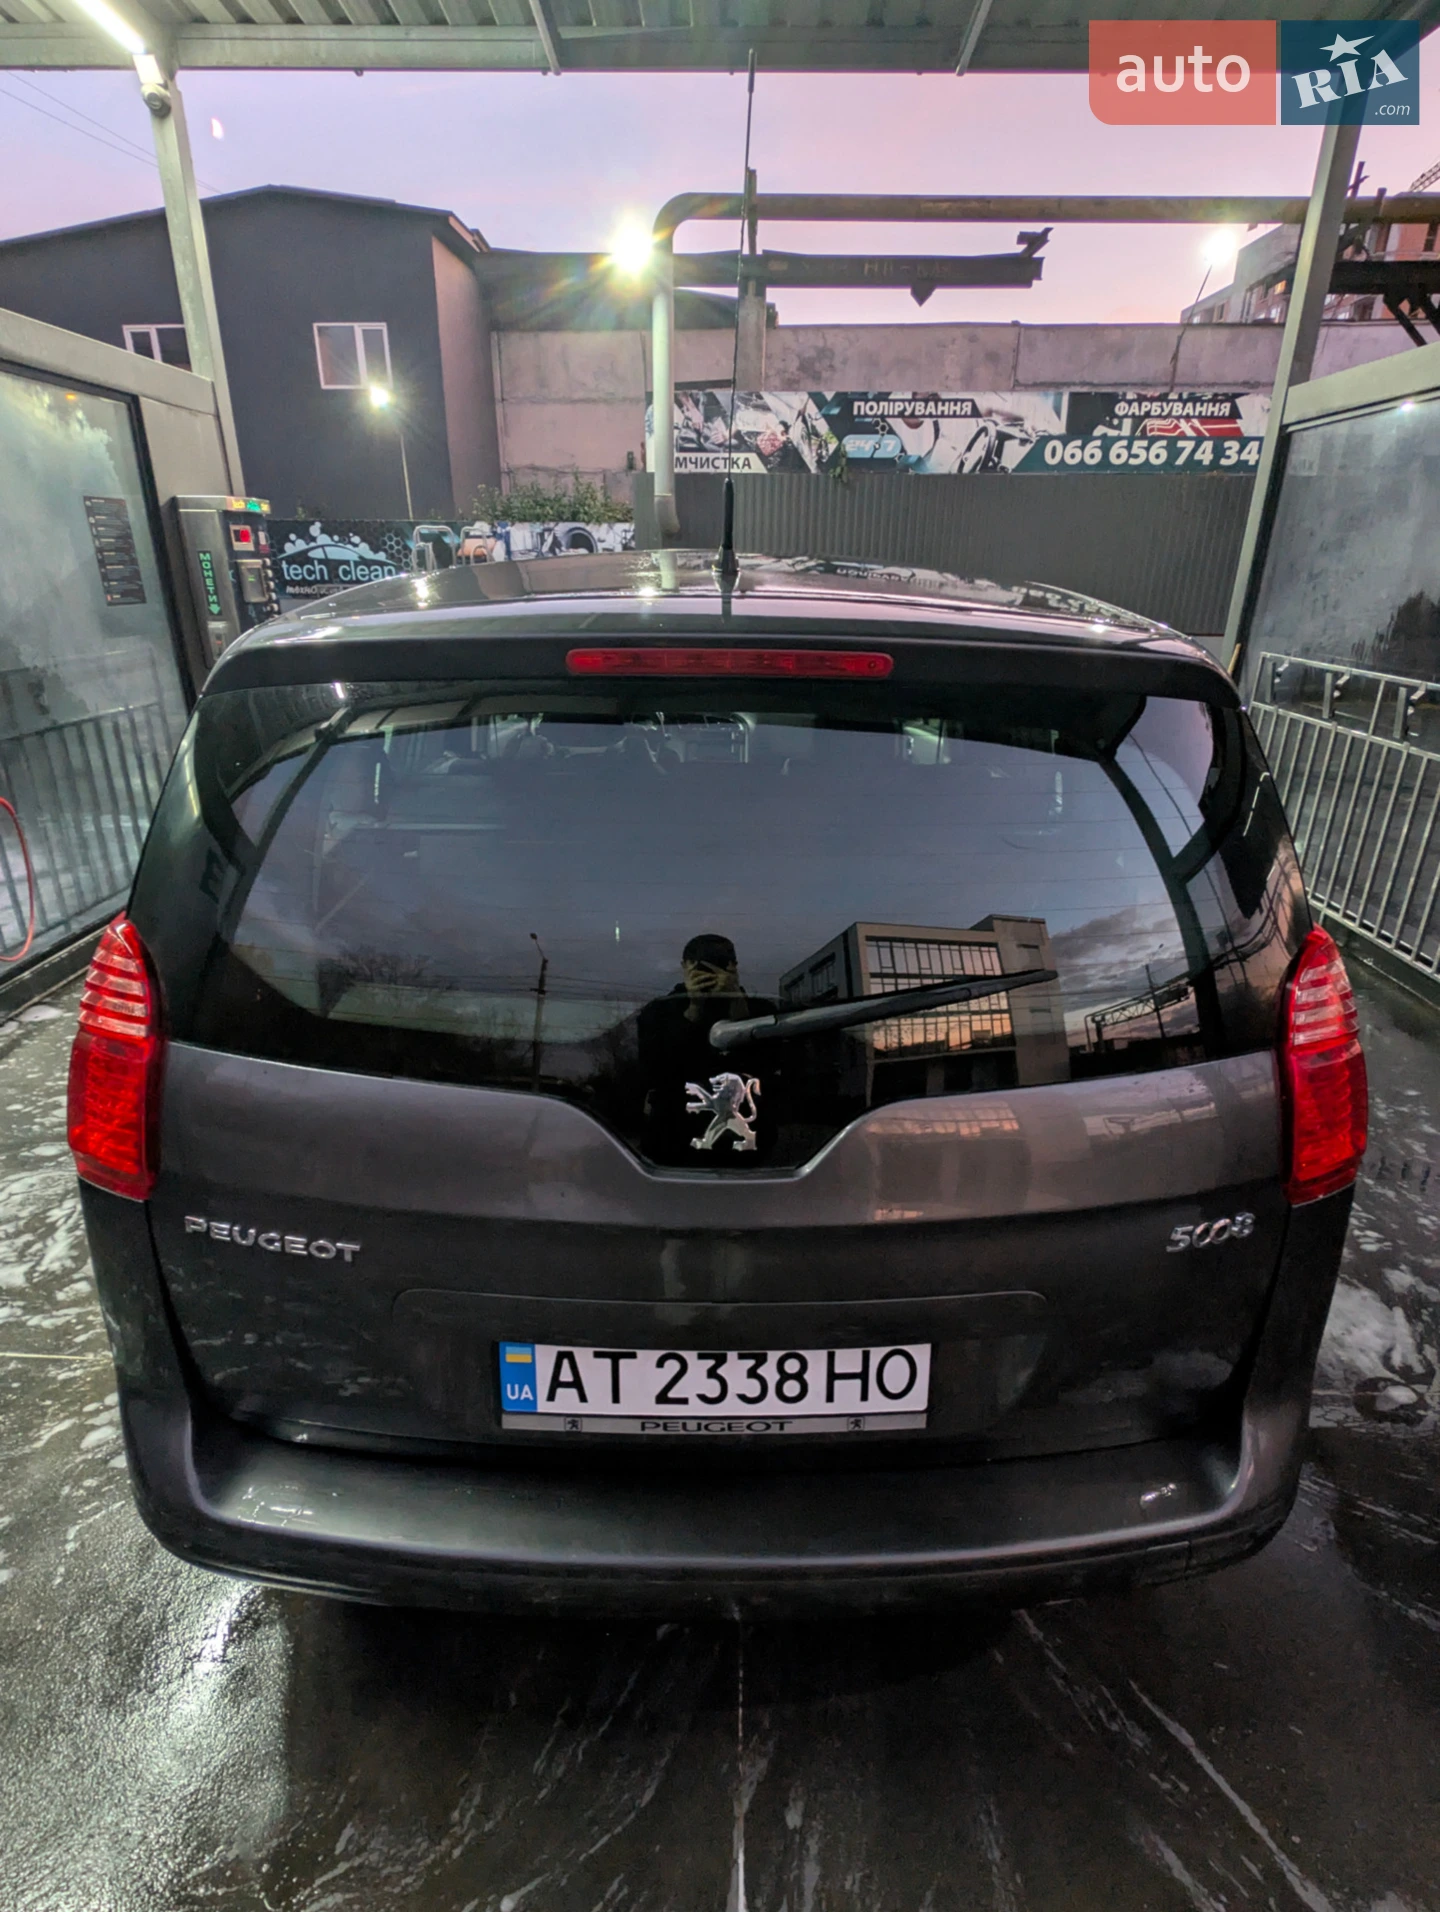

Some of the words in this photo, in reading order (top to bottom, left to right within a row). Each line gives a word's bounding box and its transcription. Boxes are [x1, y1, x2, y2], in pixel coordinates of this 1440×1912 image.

[853, 401, 972, 415] ПОЛІРУВАННЯ
[1114, 401, 1231, 417] ФАРБУВАННЯ
[674, 456, 752, 470] МЧИСТКА
[1044, 439, 1102, 466] 066
[1109, 439, 1167, 466] 656
[1175, 440, 1214, 466] 74
[1220, 440, 1259, 466] 34
[199, 552, 218, 602] МОНЕТИ
[281, 560, 329, 581] tech
[338, 561, 396, 581] clean
[184, 1215, 361, 1262] PEUGEOT
[1166, 1212, 1256, 1252] 5008
[546, 1350, 637, 1404] AT
[655, 1352, 809, 1405] 2338
[825, 1348, 918, 1403] HO
[507, 1384, 533, 1400] UA
[640, 1420, 793, 1433] PEUGEOT
